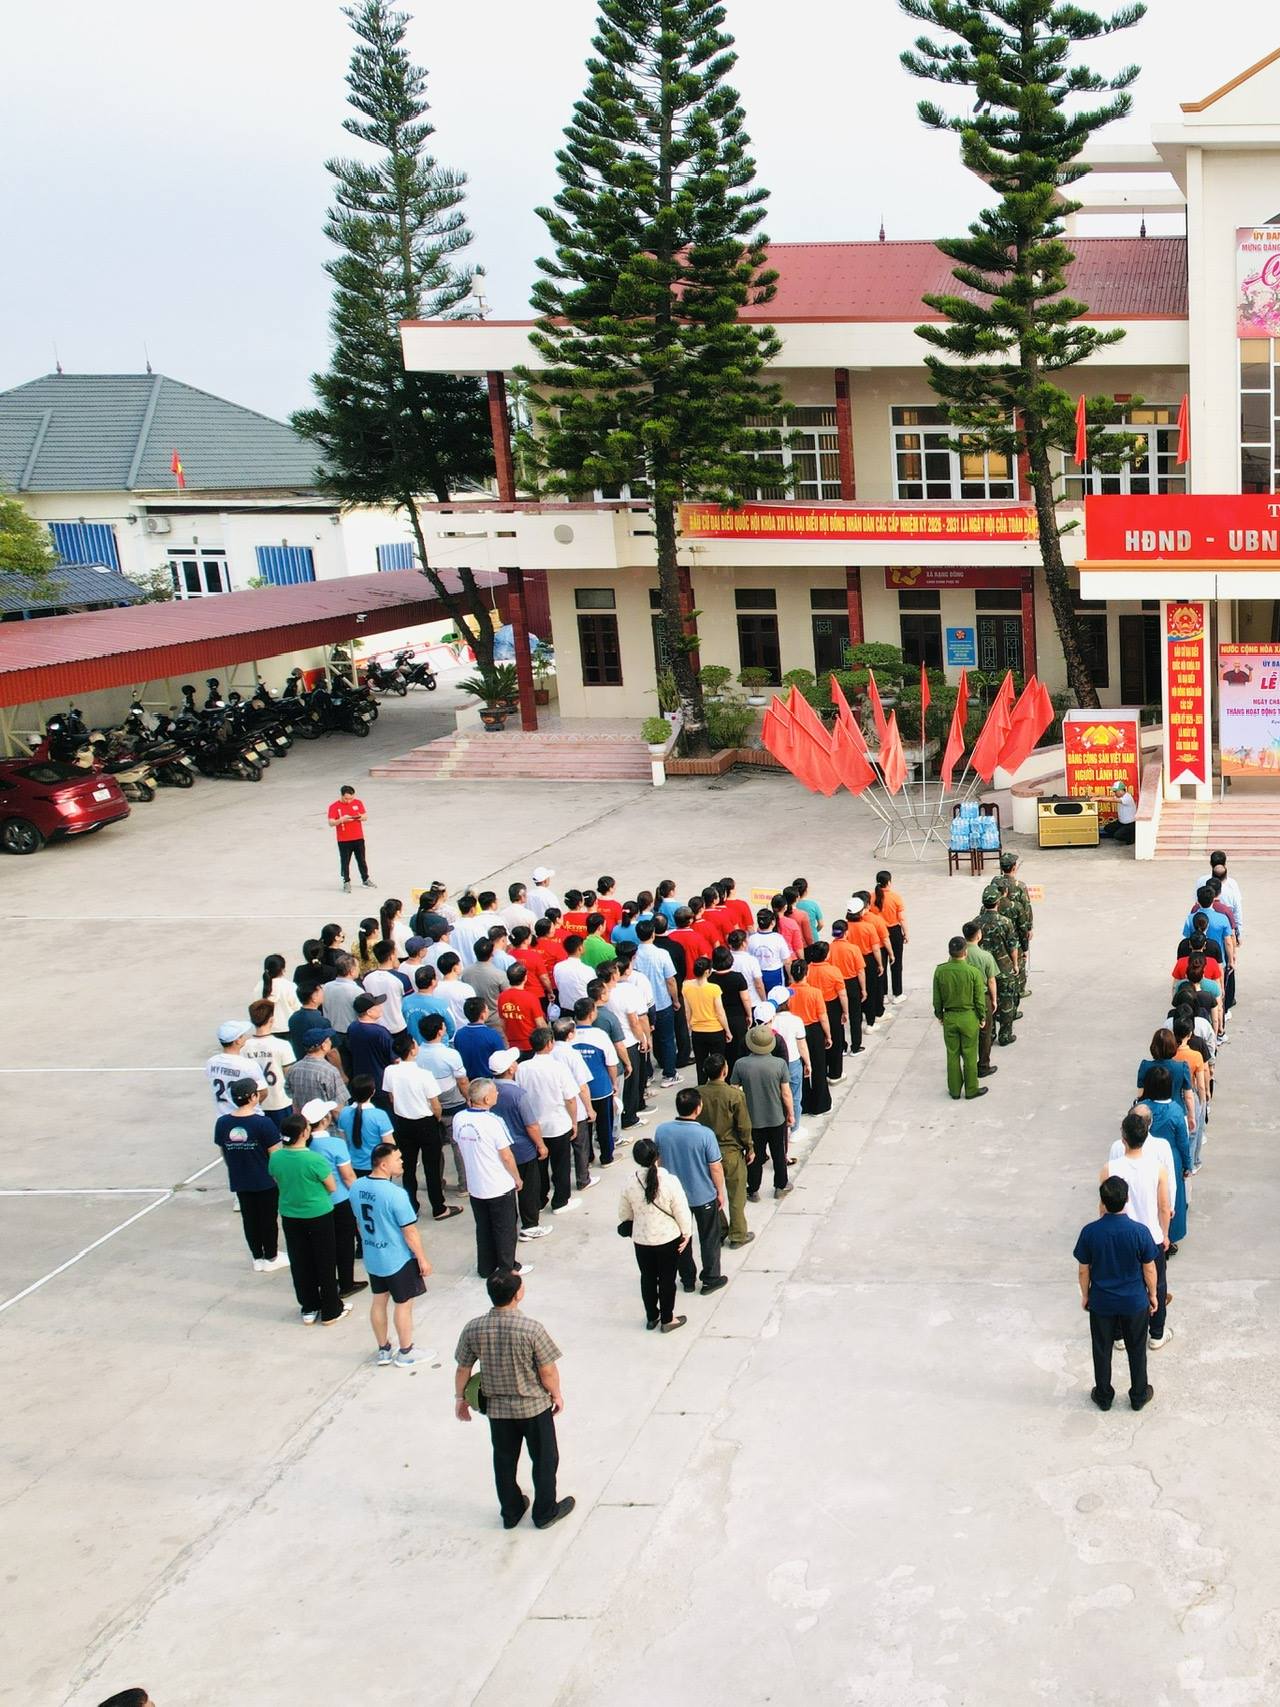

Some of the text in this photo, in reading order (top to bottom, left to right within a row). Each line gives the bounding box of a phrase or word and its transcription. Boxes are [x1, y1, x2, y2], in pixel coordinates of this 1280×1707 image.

[1125, 530, 1192, 552] HĐND
[1260, 671, 1277, 690] LỄ
[264, 1061, 277, 1087] 6
[360, 1203, 375, 1235] 5
